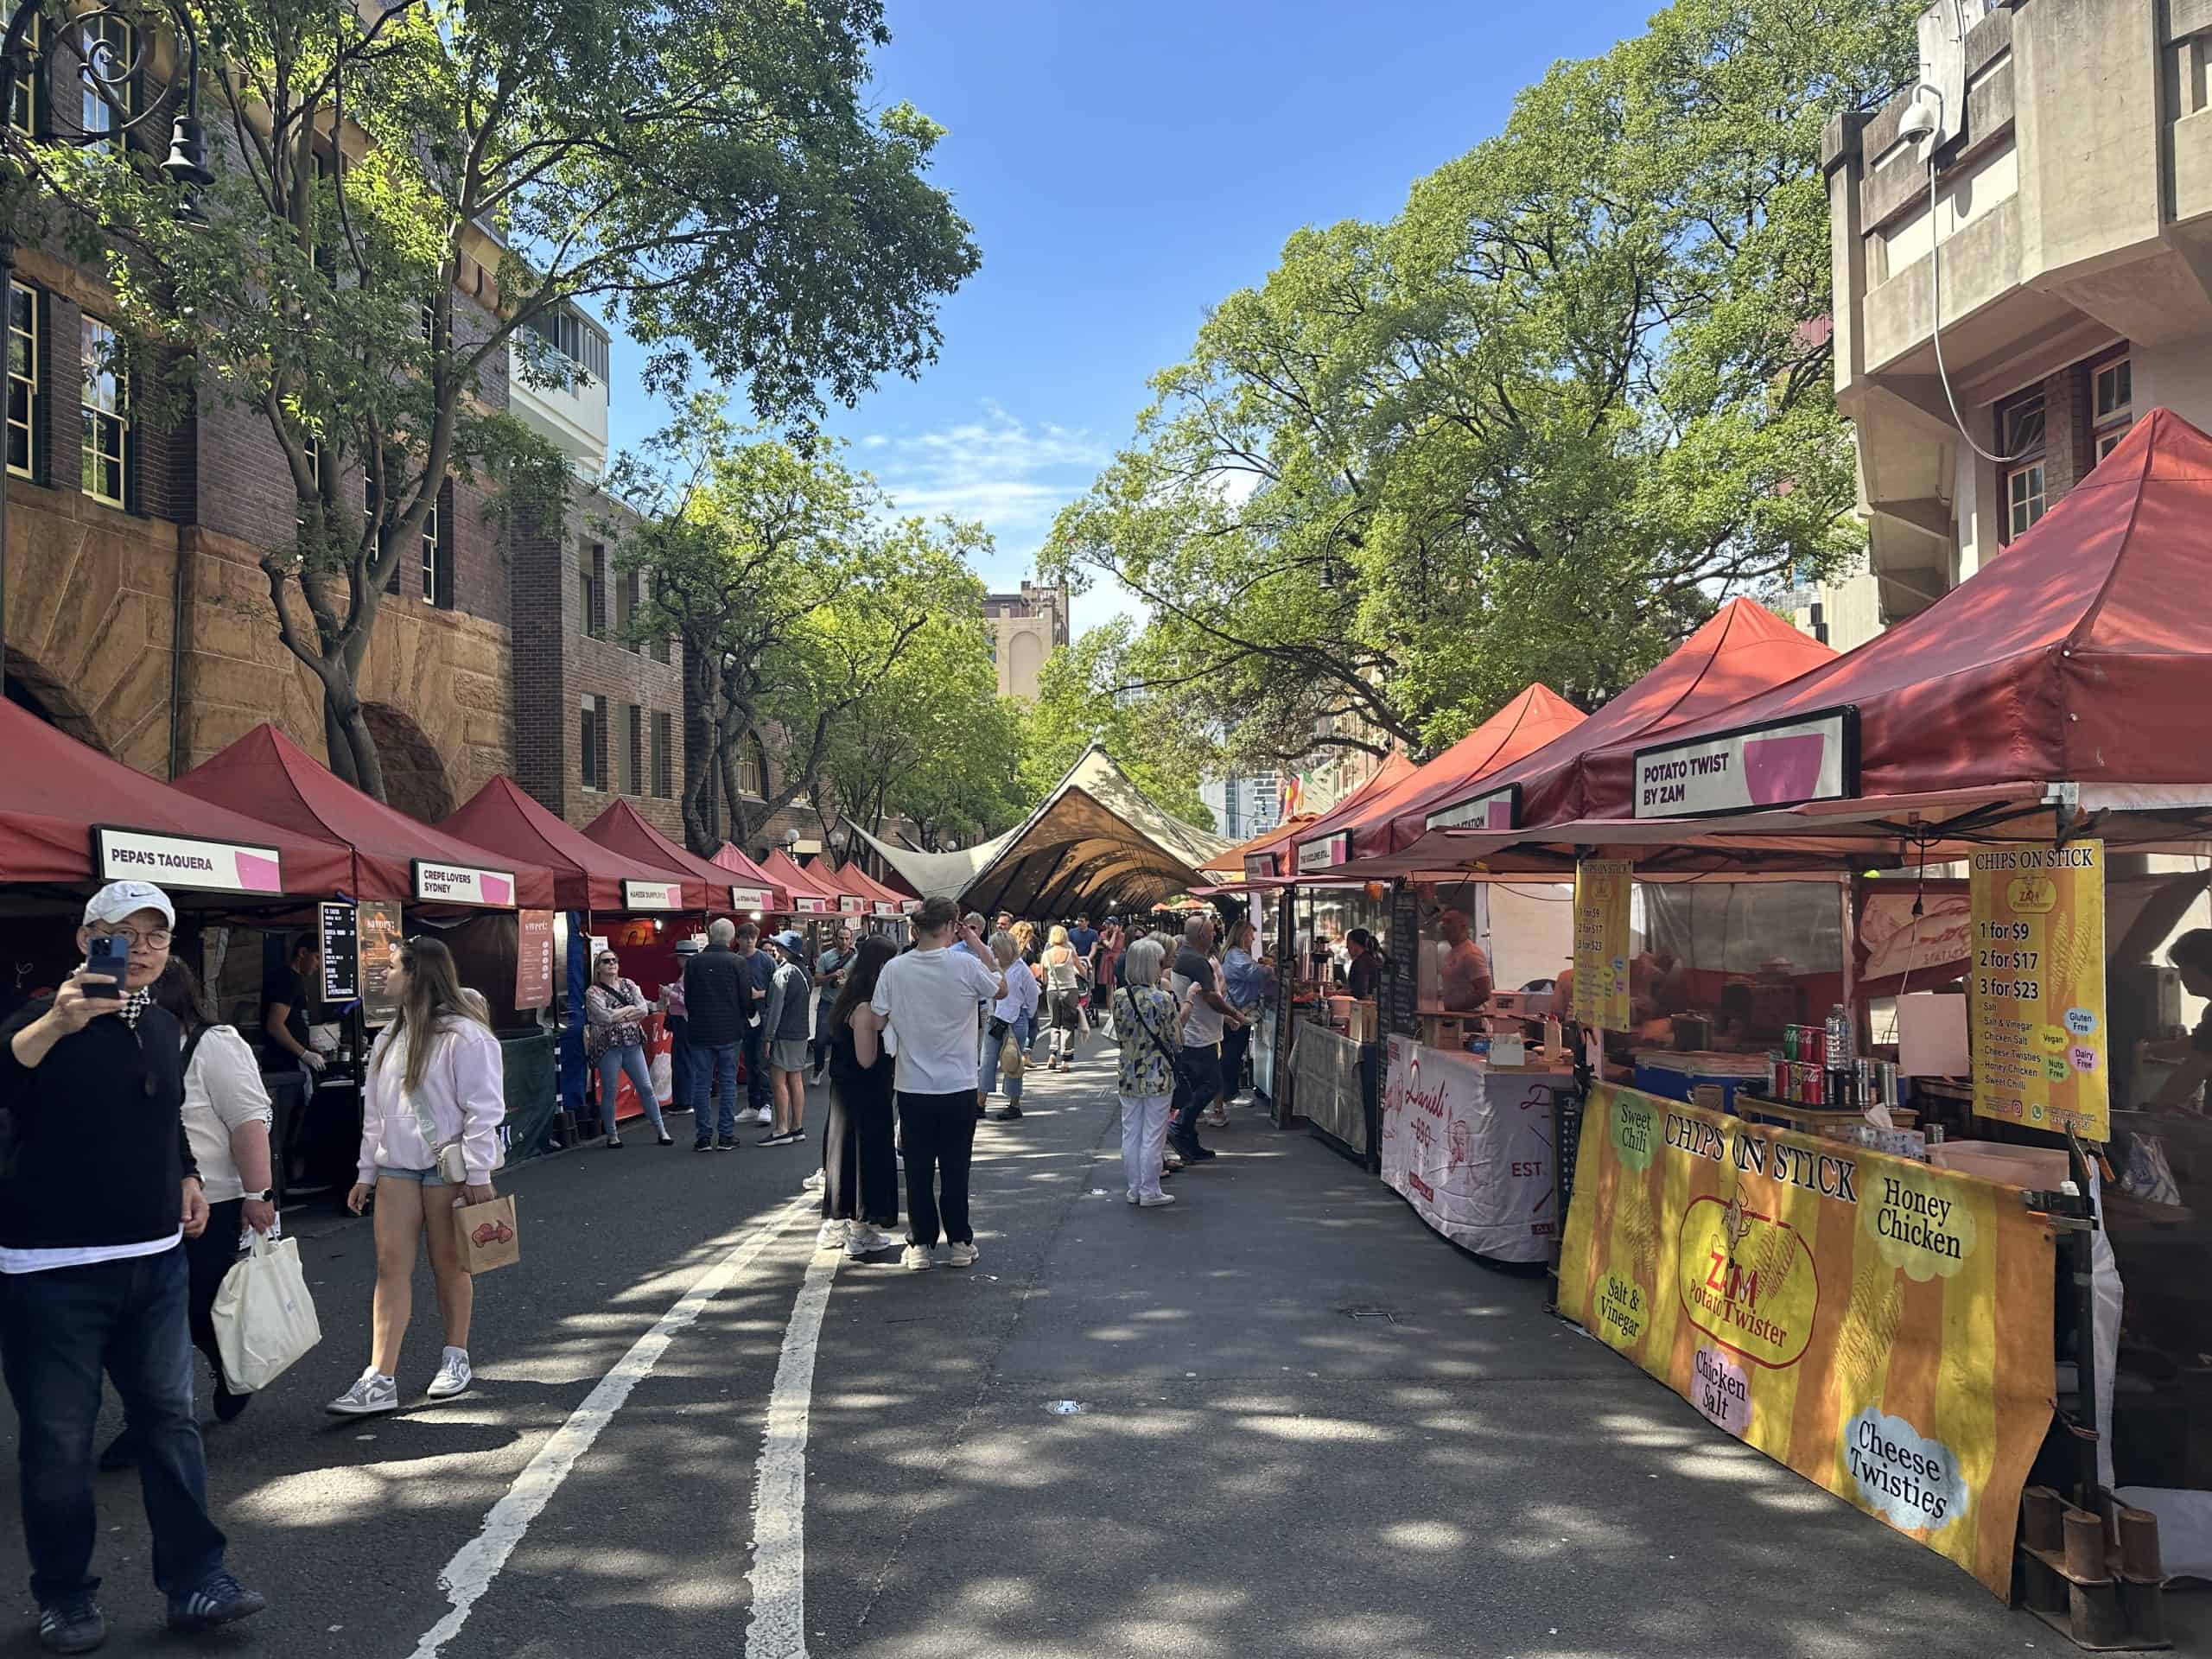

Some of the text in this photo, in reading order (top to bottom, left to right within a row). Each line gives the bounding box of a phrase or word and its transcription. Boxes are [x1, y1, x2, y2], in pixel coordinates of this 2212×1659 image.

[1643, 752, 1730, 784] POTATO TWIST
[1643, 784, 1685, 806] BY ZAM
[111, 848, 213, 871] PEPA'S TAQUERA
[1975, 848, 2094, 870] CHIPS ON STICK
[423, 869, 471, 884] CREPE LOVERS
[423, 882, 451, 893] SYDNEY
[1980, 922, 1986, 938] 1
[1990, 921, 2009, 939] for
[2012, 921, 2030, 940] $9
[1980, 949, 2038, 970] 2 for $17
[1980, 977, 2039, 1000] 3 for $23
[1983, 1001, 1997, 1011] Salt
[1983, 1016, 1997, 1026] Salt
[2005, 1020, 2033, 1032] Vinegar
[2069, 1012, 2093, 1023] Gluten
[2073, 1023, 2088, 1032] Free
[1984, 1031, 2028, 1045] Chicken Salt
[2043, 1033, 2063, 1044] Vegan
[1984, 1046, 2041, 1063] Cheese Twisties
[2048, 1058, 2064, 1070] Nuts
[2075, 1048, 2094, 1060] Dairy
[2075, 1059, 2092, 1069] Free
[1985, 1061, 2038, 1077] Honey Chicken
[1985, 1074, 2005, 1085] Sweet
[2049, 1070, 2063, 1079] Free
[1621, 1104, 1651, 1131] Sweet
[1622, 1128, 1647, 1154] Chili
[1665, 1113, 1725, 1161] CHIPS
[1773, 1142, 1857, 1203] STICK
[1883, 1177, 1952, 1227] Honey
[1877, 1208, 1962, 1260] Chicken
[1608, 1276, 1640, 1313] Salt &
[1600, 1296, 1640, 1338] Vinegar
[1690, 1278, 1788, 1348] Potato Twister
[1695, 1350, 1746, 1402] Chicken
[1702, 1383, 1729, 1420] Salt
[1859, 1420, 1941, 1482] Cheese
[1850, 1446, 1948, 1519] Twisties
